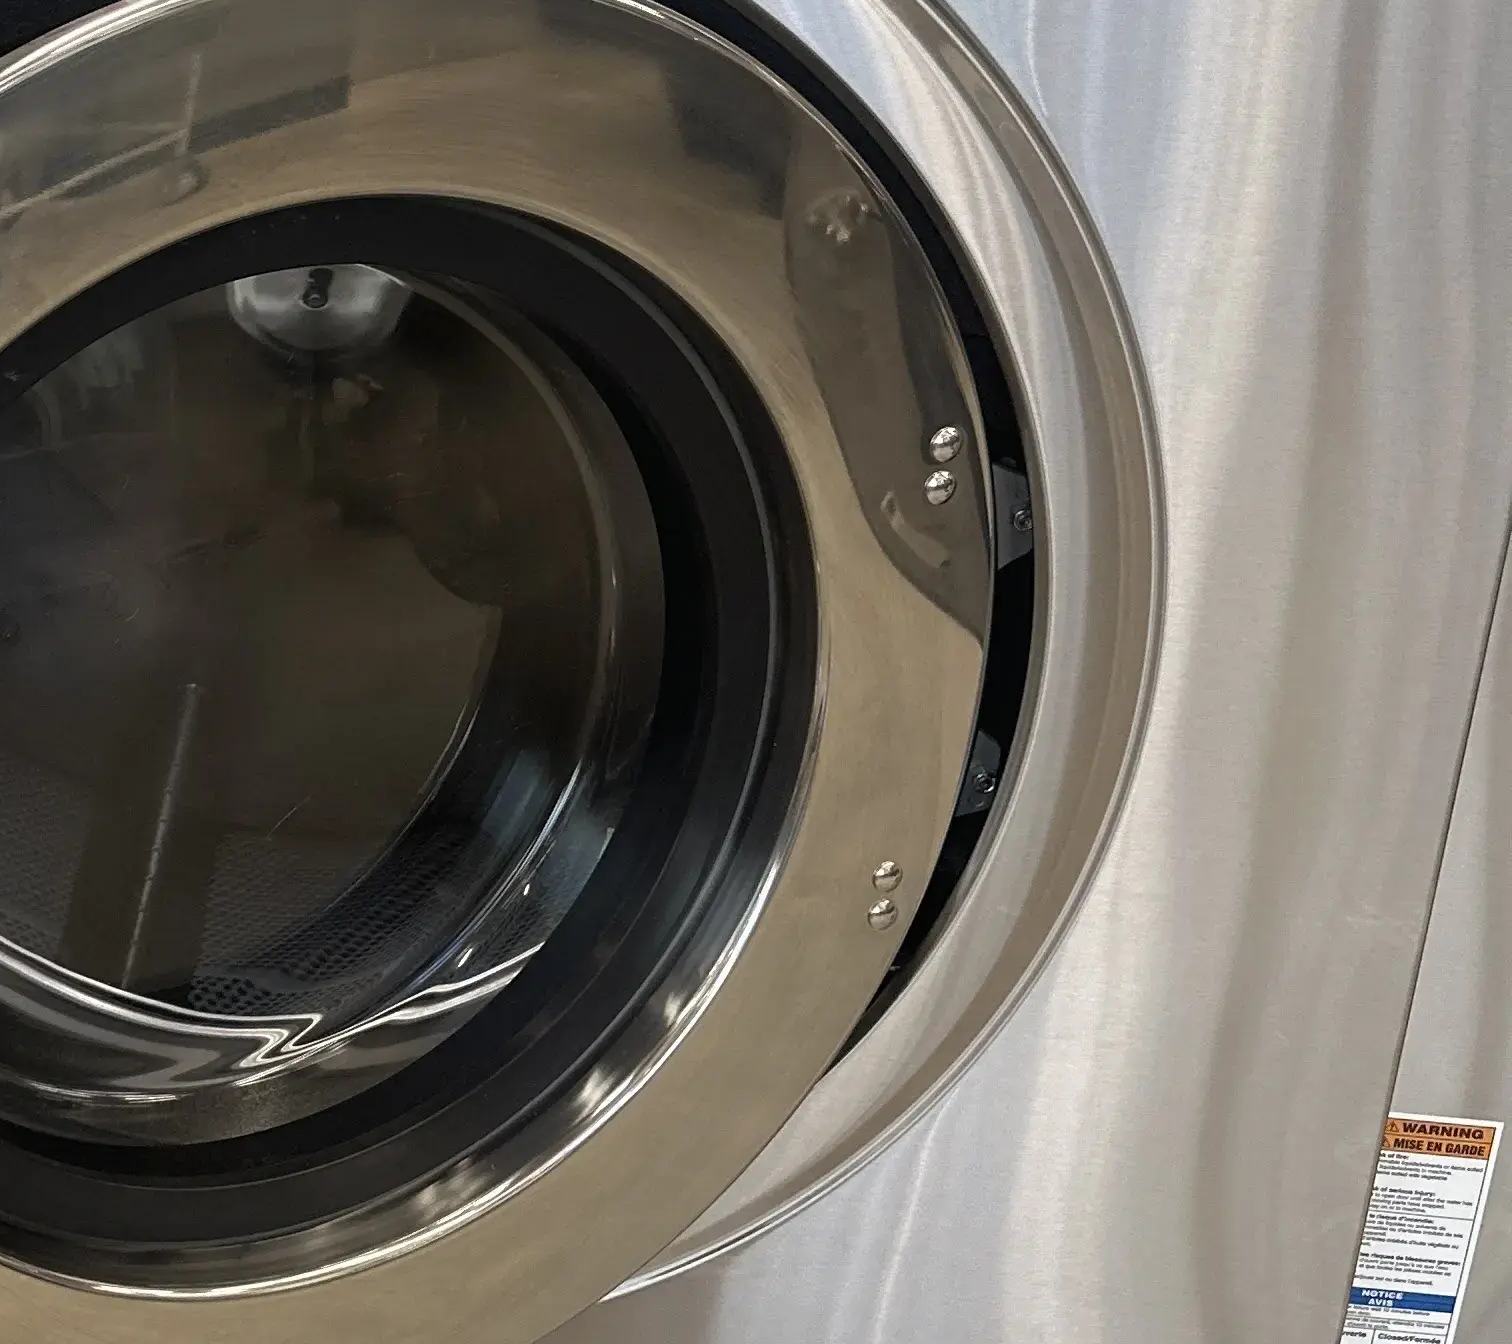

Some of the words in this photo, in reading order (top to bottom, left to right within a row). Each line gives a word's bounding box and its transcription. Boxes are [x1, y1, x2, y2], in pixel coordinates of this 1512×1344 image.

[1402, 1122, 1484, 1140] WARNING
[1392, 1138, 1424, 1151] MISE
[1426, 1142, 1443, 1152] EN
[1444, 1143, 1486, 1157] GARDE
[1362, 1289, 1403, 1300] NOTICE
[1368, 1298, 1393, 1306] AVIS
